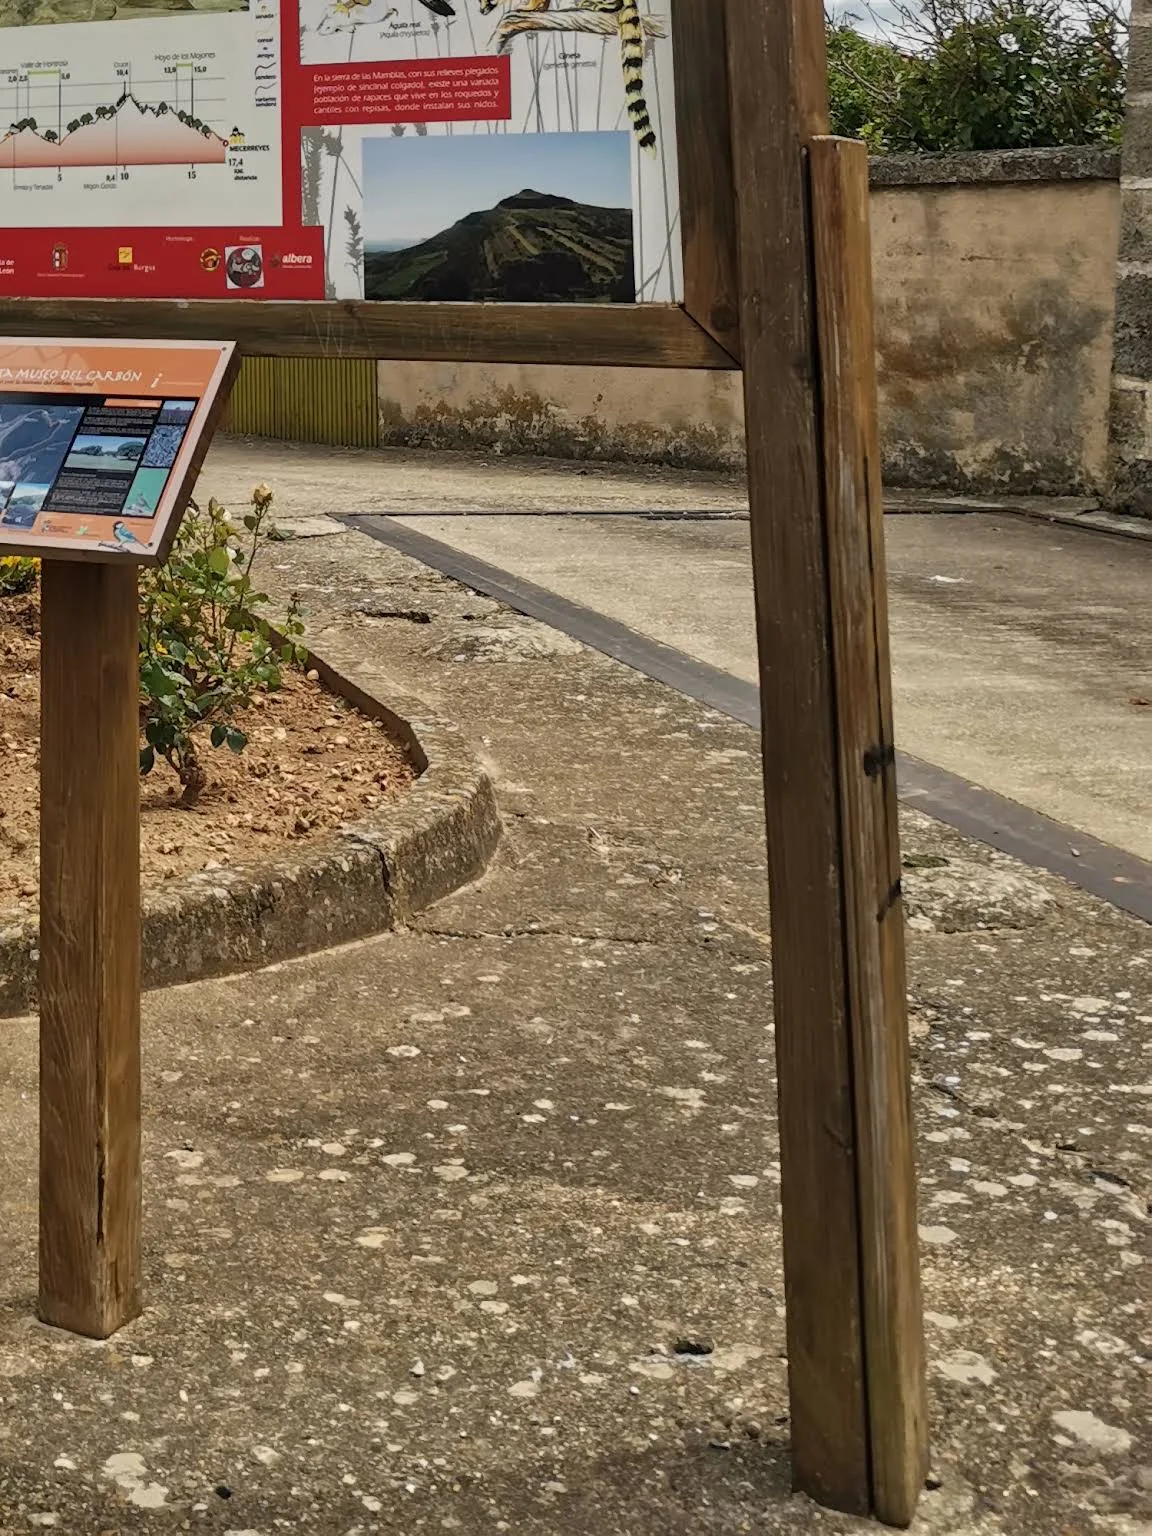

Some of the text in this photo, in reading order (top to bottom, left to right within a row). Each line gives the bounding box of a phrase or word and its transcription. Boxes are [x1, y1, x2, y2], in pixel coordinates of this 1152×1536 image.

[313, 73, 322, 81] En
[361, 71, 371, 79] las
[351, 93, 361, 101] de
[393, 93, 408, 101] que
[440, 90, 452, 98] los
[228, 158, 243, 166] 17,4
[282, 253, 312, 263] albera
[16, 368, 59, 380] MUSEO
[61, 369, 82, 380] DEL
[86, 369, 142, 382] CARBÓN
